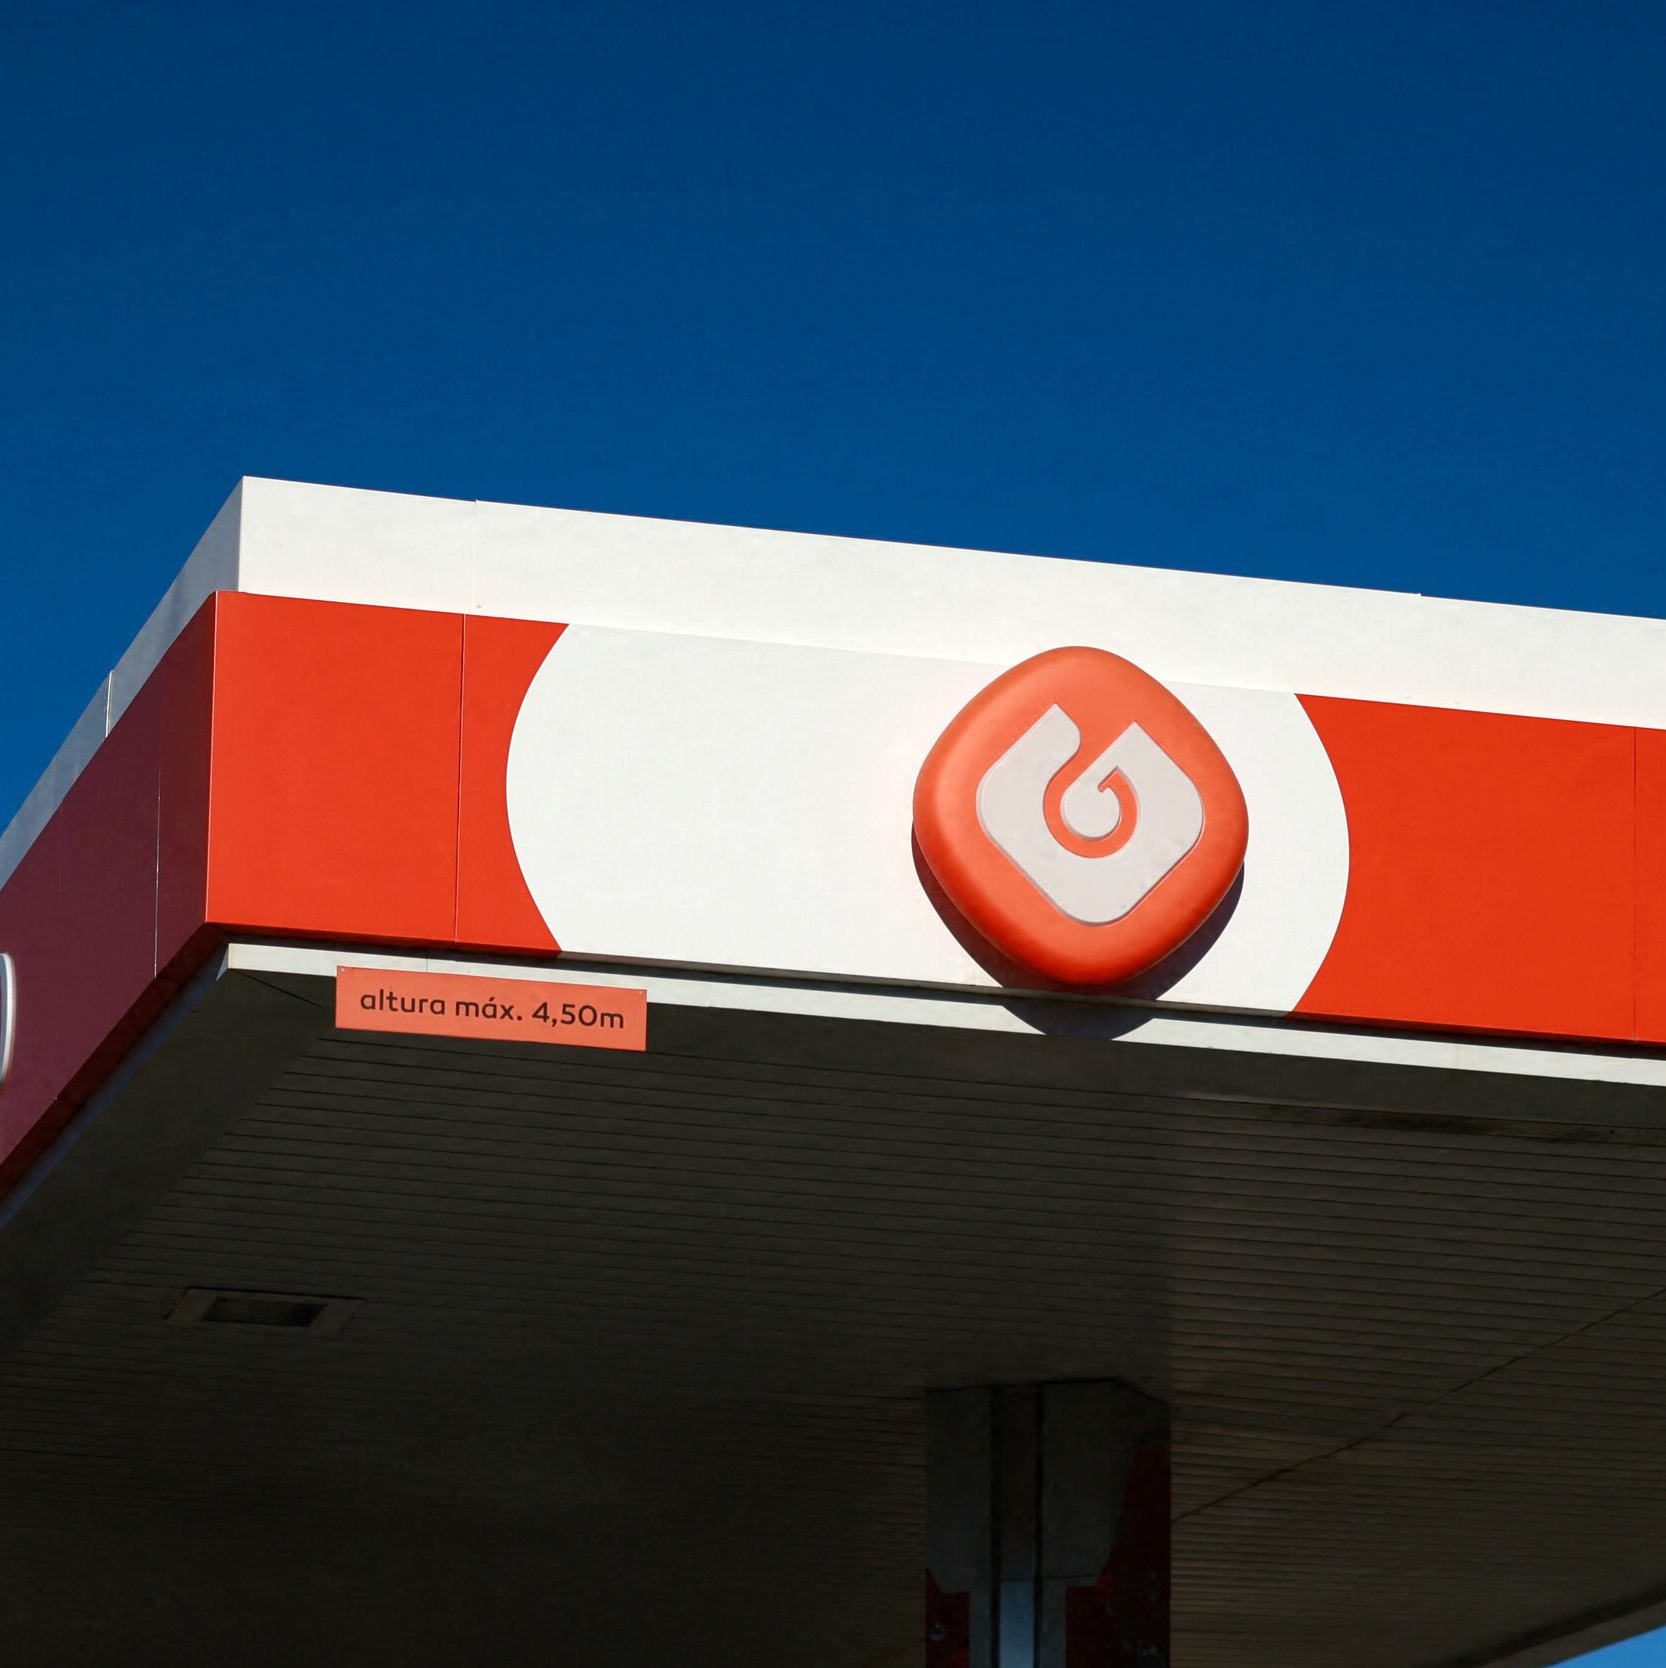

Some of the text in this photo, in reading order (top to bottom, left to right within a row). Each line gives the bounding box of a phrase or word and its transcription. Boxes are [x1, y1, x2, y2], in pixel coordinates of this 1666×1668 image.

[360, 989, 625, 1030] altura máx. 4,50m
